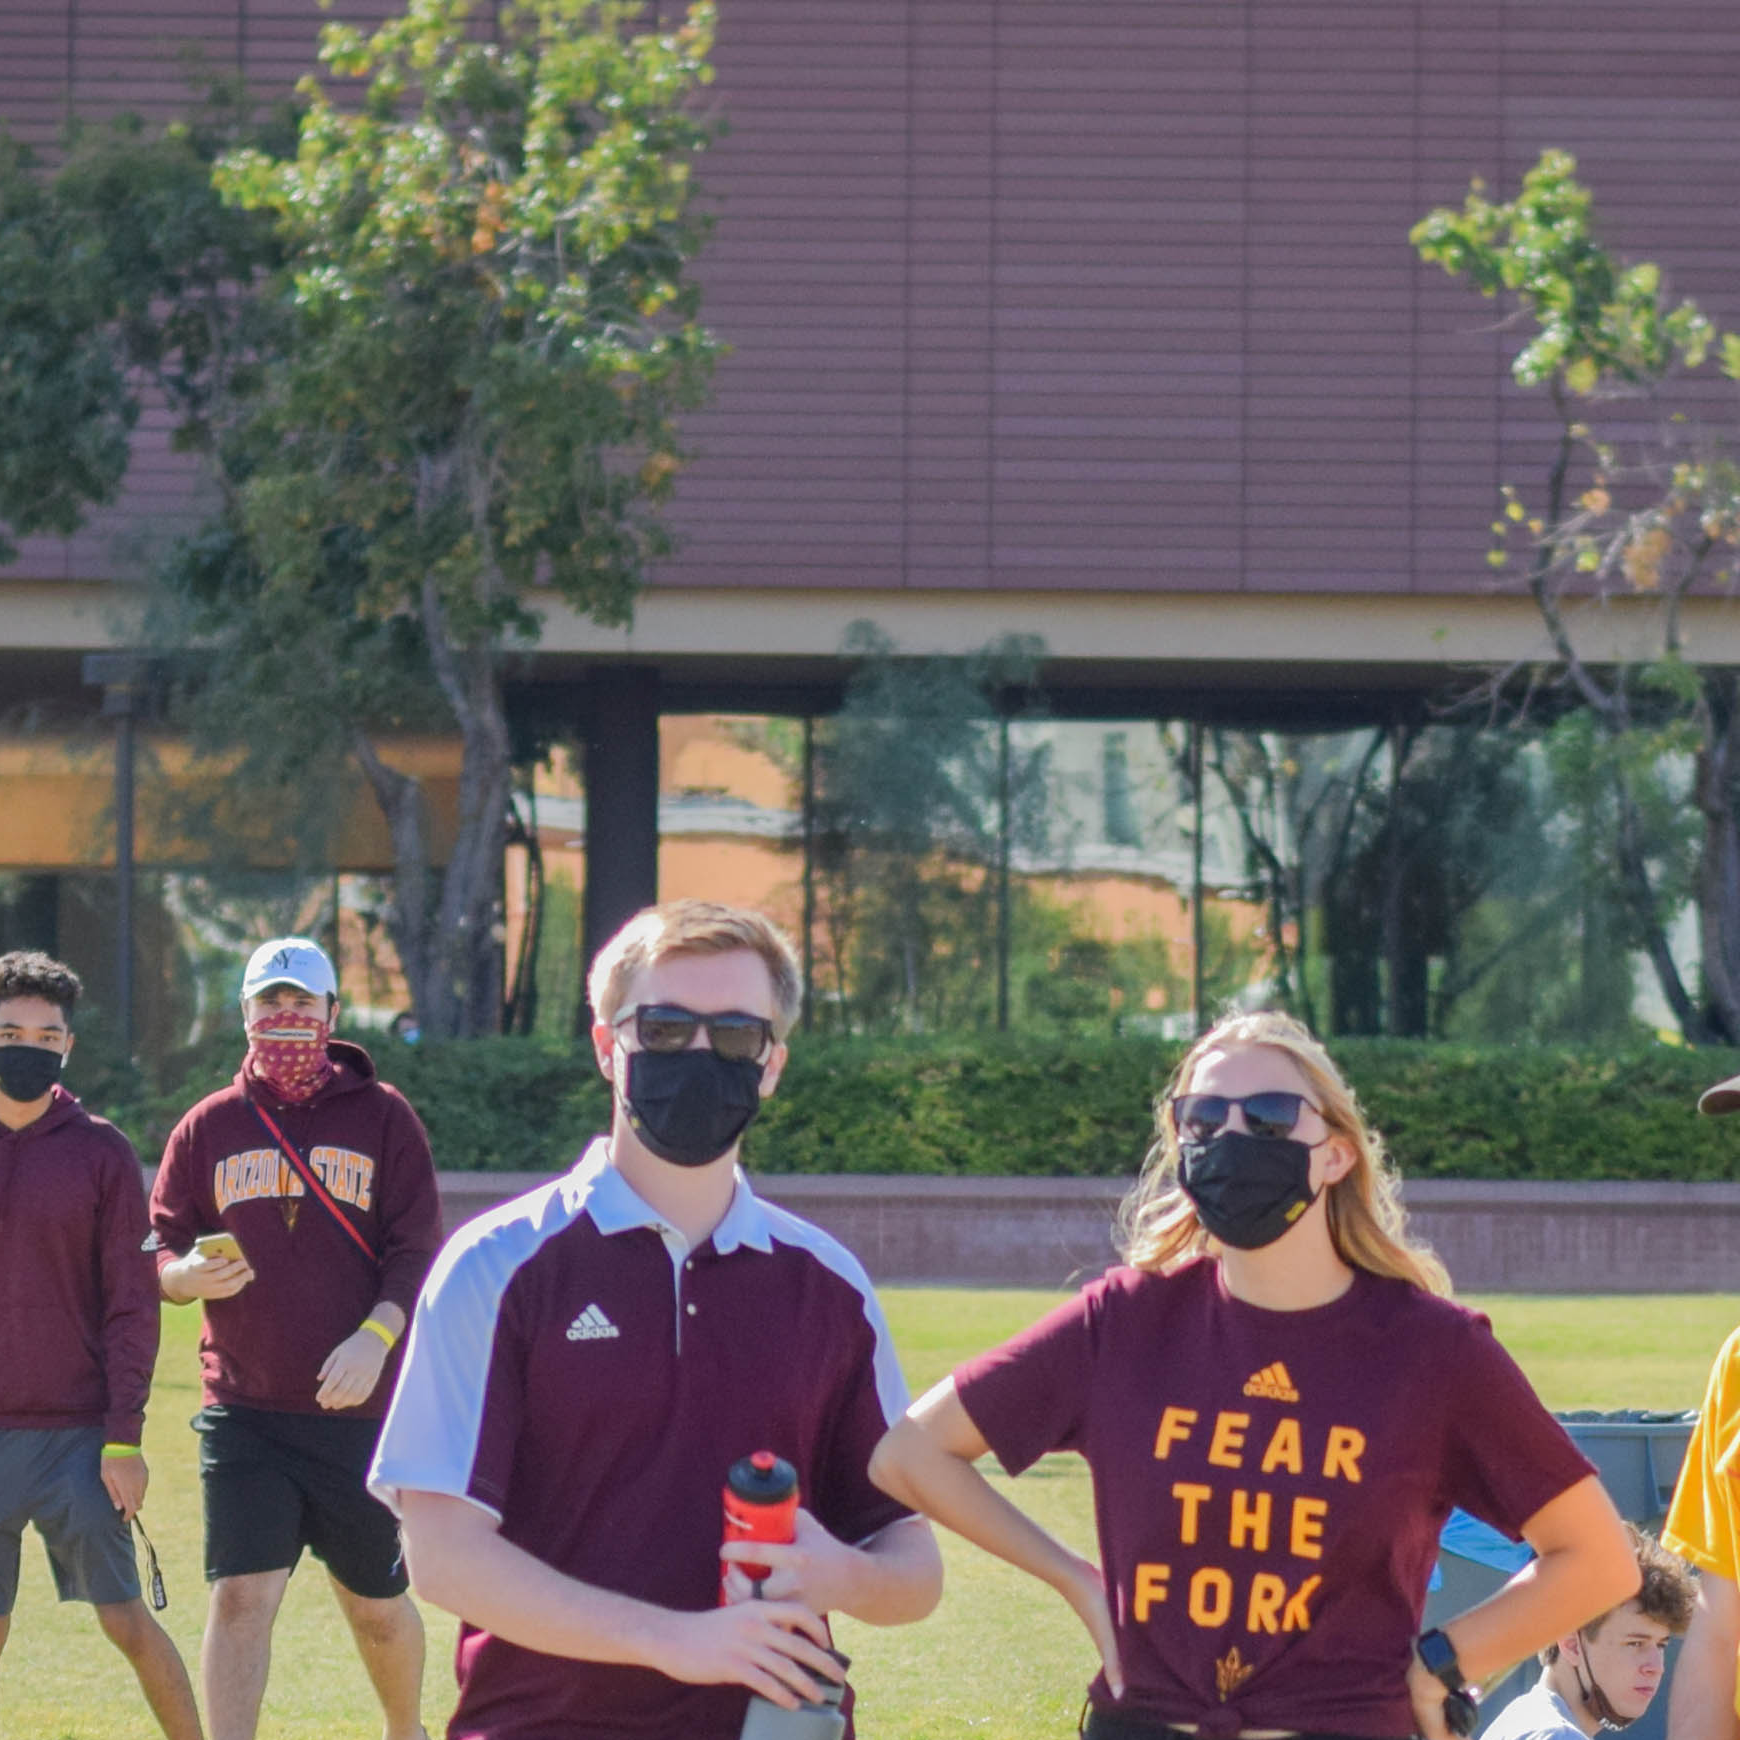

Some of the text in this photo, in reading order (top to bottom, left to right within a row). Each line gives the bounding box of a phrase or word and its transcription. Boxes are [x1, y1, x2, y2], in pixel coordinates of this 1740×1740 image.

[309, 1146, 375, 1212] STATE
[1242, 1381, 1300, 1403] adidas
[1154, 1405, 1366, 1484] FEAR
[1172, 1482, 1328, 1560] THE
[1134, 1562, 1322, 1634] FORK
